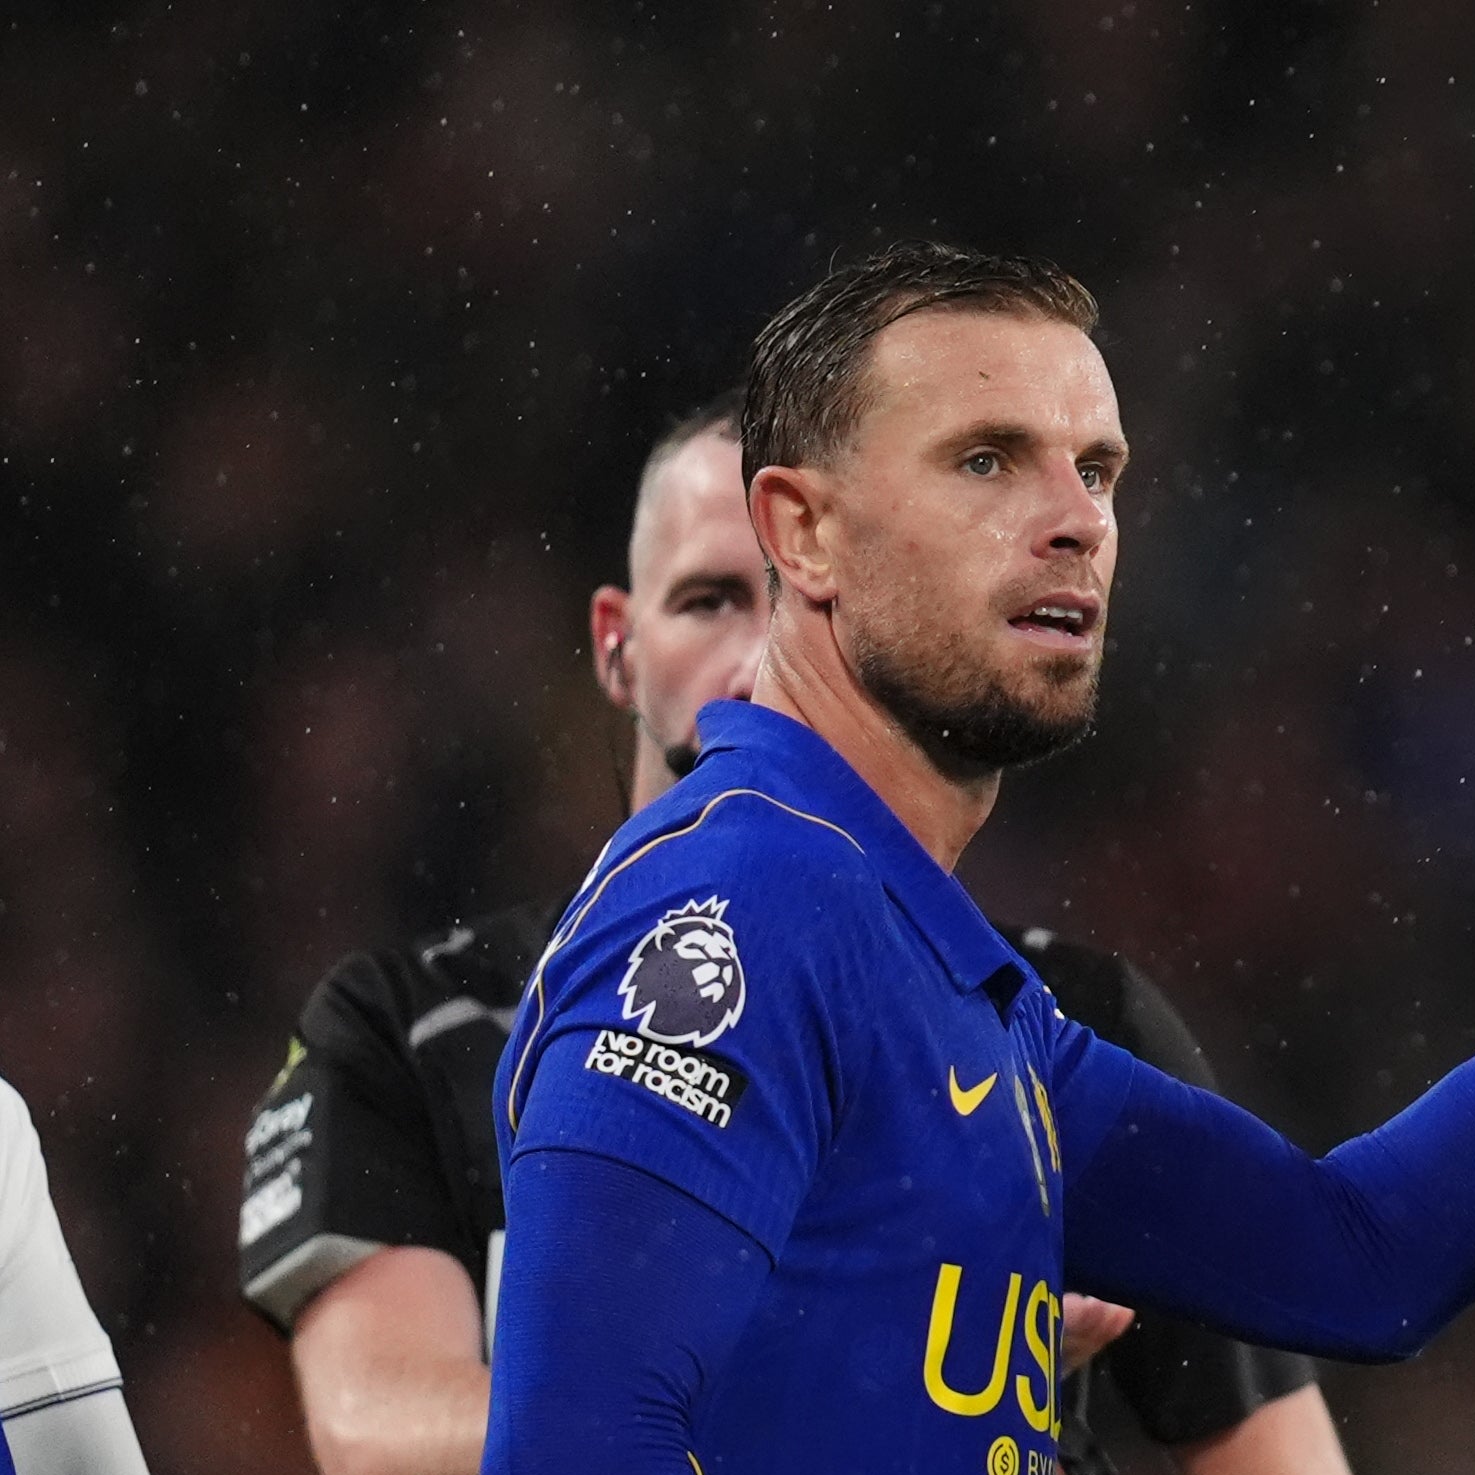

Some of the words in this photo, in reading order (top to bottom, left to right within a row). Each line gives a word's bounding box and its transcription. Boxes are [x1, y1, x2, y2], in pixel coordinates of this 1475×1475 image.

[585, 1045, 635, 1077] for
[631, 1063, 732, 1128] racism
[594, 1030, 644, 1057] No
[644, 1043, 730, 1098] room
